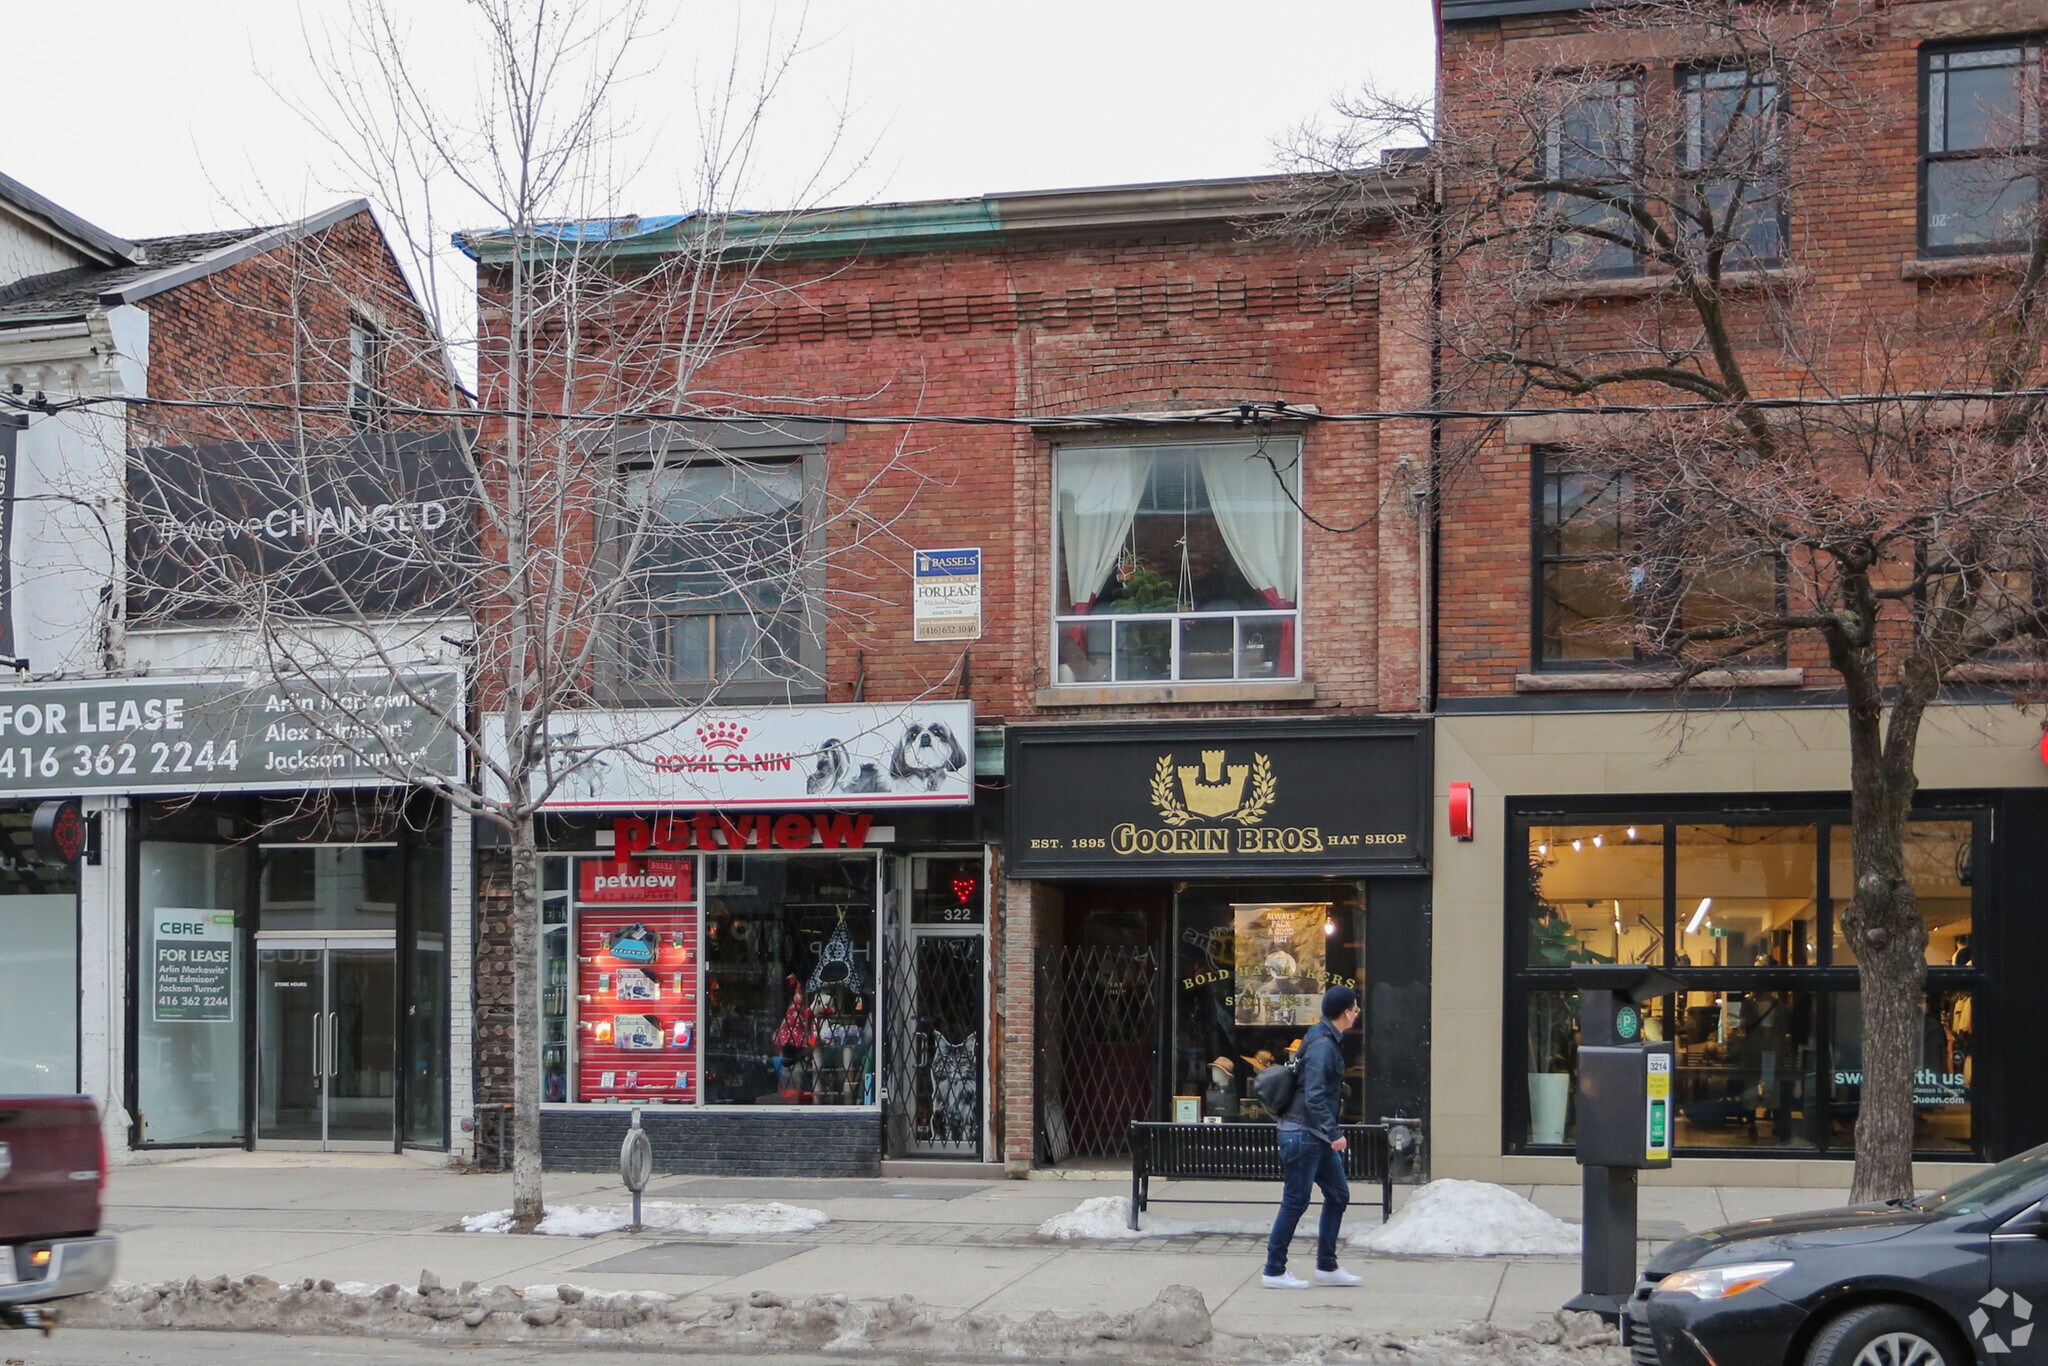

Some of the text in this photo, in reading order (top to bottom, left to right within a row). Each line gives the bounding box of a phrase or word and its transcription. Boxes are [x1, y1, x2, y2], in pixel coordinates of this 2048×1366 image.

[932, 556, 976, 567] BASSELS
[918, 586, 941, 598] FOR
[0, 698, 184, 737] FOR LEASE
[265, 722, 309, 742] Alex
[0, 739, 239, 779] 416 362 2244
[264, 749, 346, 770] Jackson
[654, 752, 791, 773] ROYAL CANIN
[613, 810, 874, 864] petview
[1030, 822, 1407, 855] EST. 1895 GOORIN BROS. HAT SHOP
[594, 869, 677, 892] petview
[943, 908, 971, 921] 322
[1266, 912, 1296, 920] ALWAYS
[159, 922, 205, 935] CBRE
[1271, 920, 1290, 928] PACK
[1274, 935, 1288, 943] HAT
[159, 948, 229, 963] FOR LEASE
[158, 965, 180, 973] Arlin
[158, 974, 178, 983] Alex
[1183, 969, 1230, 990] BOLD
[158, 984, 192, 993] Jackson
[158, 996, 229, 1006] 416 362 2244
[1649, 1061, 1668, 1071] 3214
[1913, 1068, 1938, 1085] ith
[1942, 1072, 1965, 1085] us
